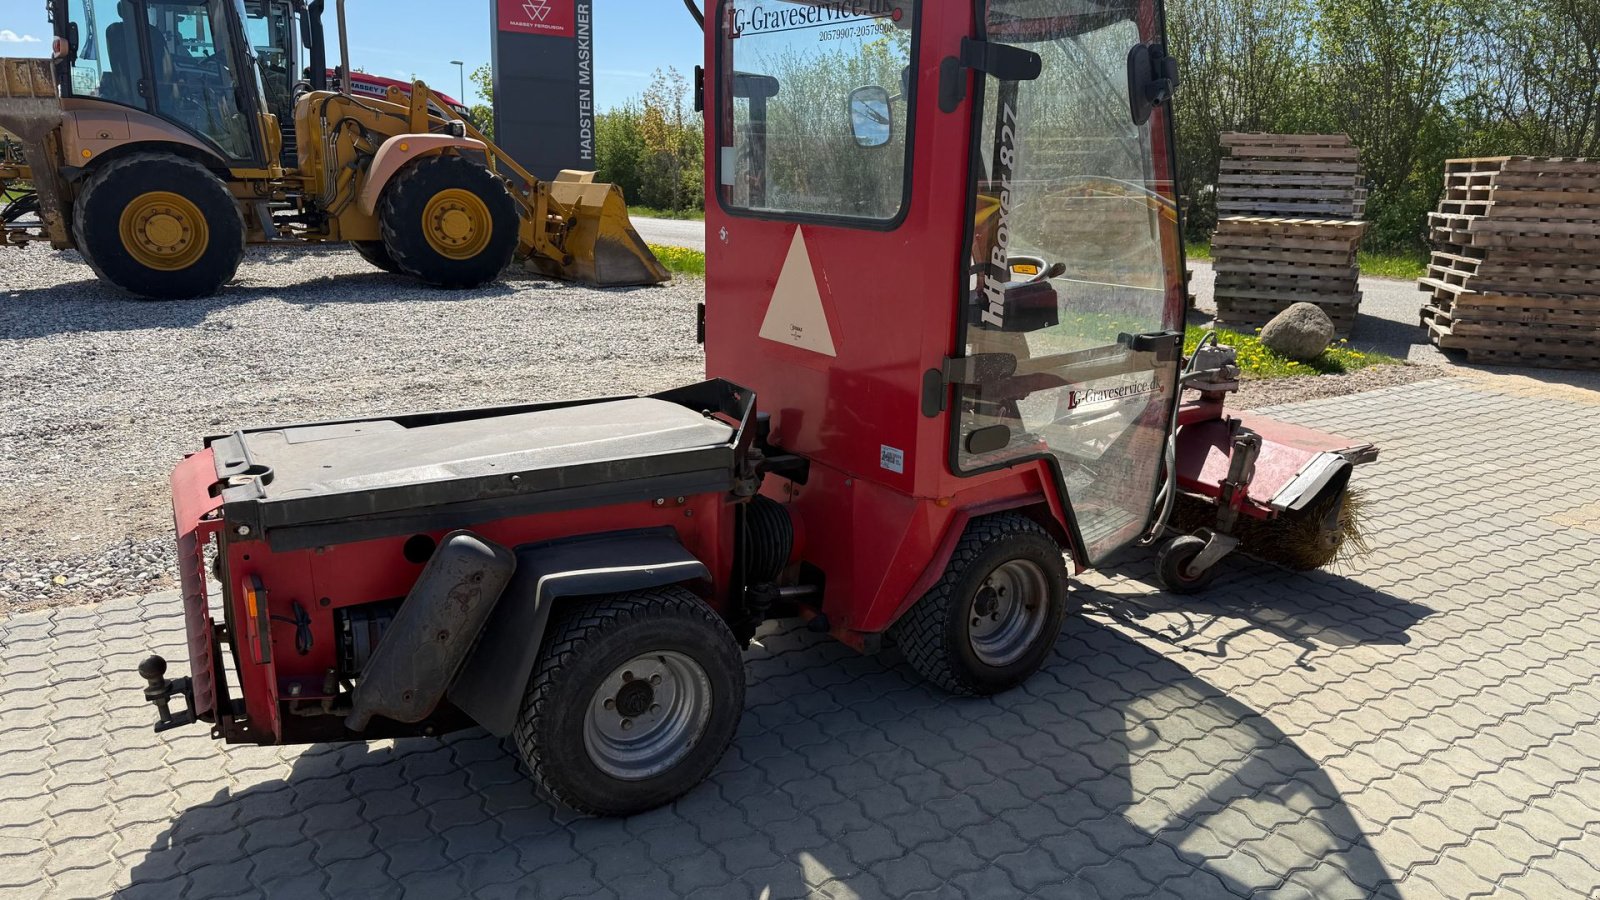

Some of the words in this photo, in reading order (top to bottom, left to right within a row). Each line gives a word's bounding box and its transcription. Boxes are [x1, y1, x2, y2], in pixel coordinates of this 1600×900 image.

[509, 20, 533, 28] MASSEY
[577, 3, 590, 85] MASKINER
[819, 22, 894, 42] 20579907-20579908
[579, 89, 592, 160] HADSTEN
[1000, 103, 1017, 171] 827
[991, 173, 1010, 270] Boxer
[981, 274, 1005, 328] htf
[1067, 376, 1161, 410] LG-Graveservice.dk
